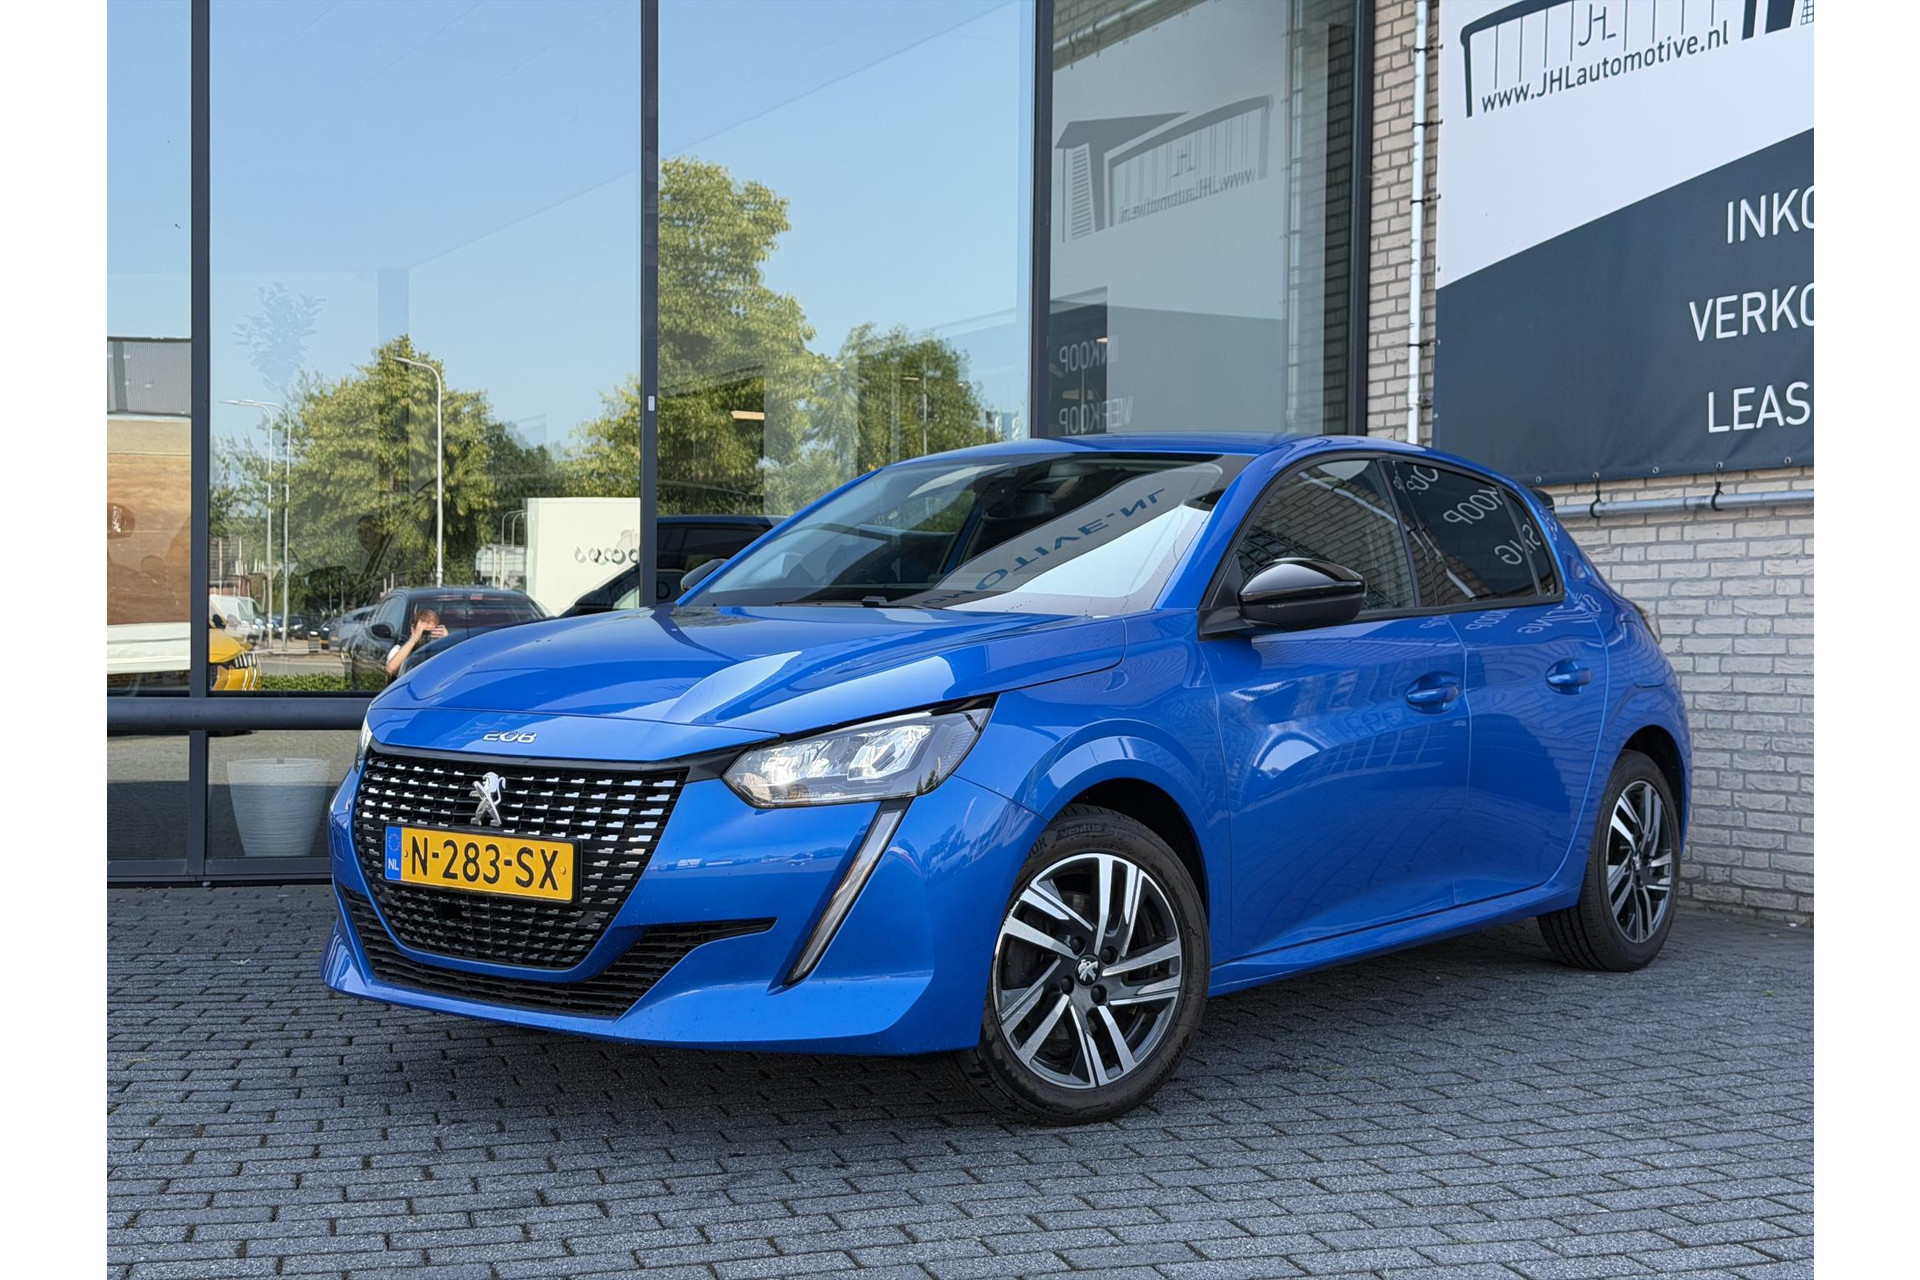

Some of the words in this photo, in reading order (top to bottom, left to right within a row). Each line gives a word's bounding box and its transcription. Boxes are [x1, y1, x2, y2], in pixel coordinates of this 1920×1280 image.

[1577, 3, 1617, 47] JHL
[1481, 19, 1729, 114] www.JHLautomotive.nl
[1688, 282, 1814, 342] VERKO
[1708, 381, 1811, 433] LEAS
[482, 729, 538, 744] 208
[387, 857, 400, 871] NL
[411, 835, 559, 891] N-283-SX
